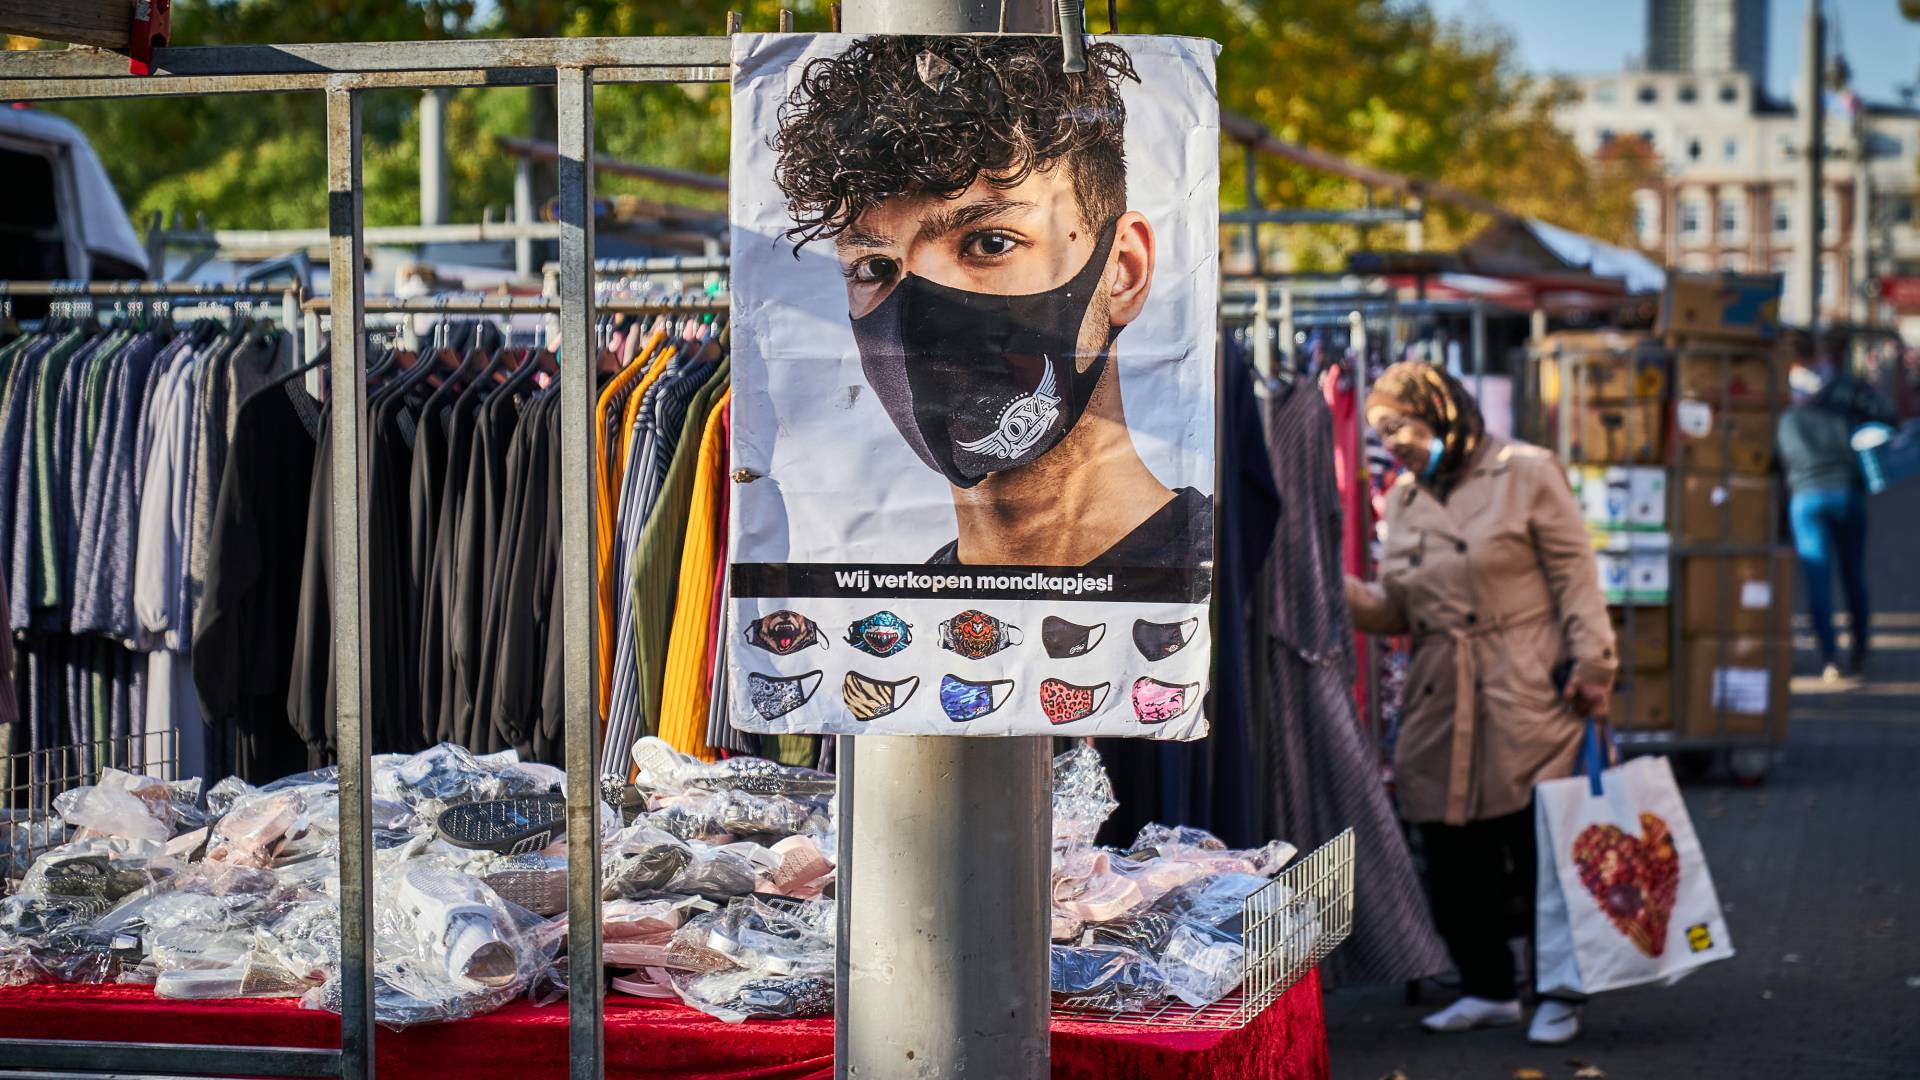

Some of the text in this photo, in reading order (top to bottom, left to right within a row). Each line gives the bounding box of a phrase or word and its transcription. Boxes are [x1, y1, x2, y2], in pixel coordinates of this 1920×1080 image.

[992, 391, 1062, 459] JOYA
[835, 571, 1113, 594] Wij verkopen mondkapjes!
